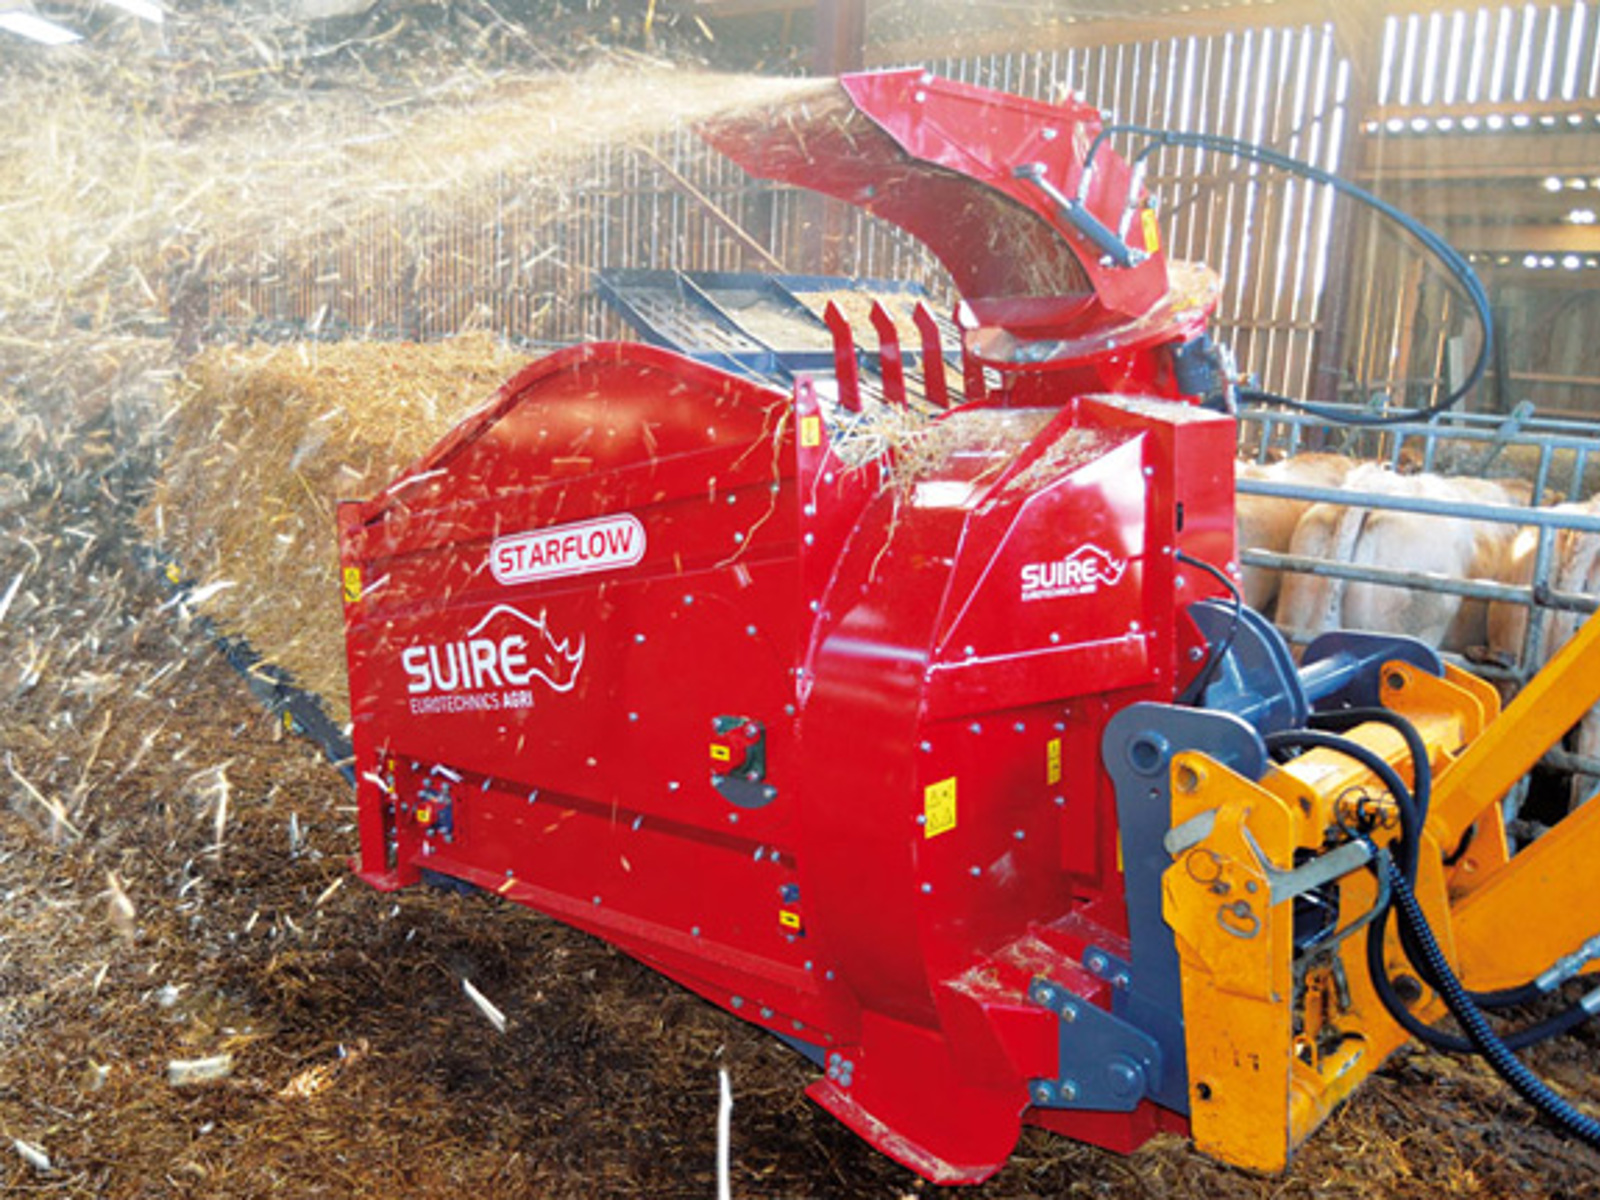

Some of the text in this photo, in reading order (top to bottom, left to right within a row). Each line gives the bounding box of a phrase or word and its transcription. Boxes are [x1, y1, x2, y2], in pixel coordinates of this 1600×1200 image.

[498, 526, 633, 574] STARFLOW
[1021, 557, 1098, 590] SUIRE
[402, 635, 530, 693] SUIRE
